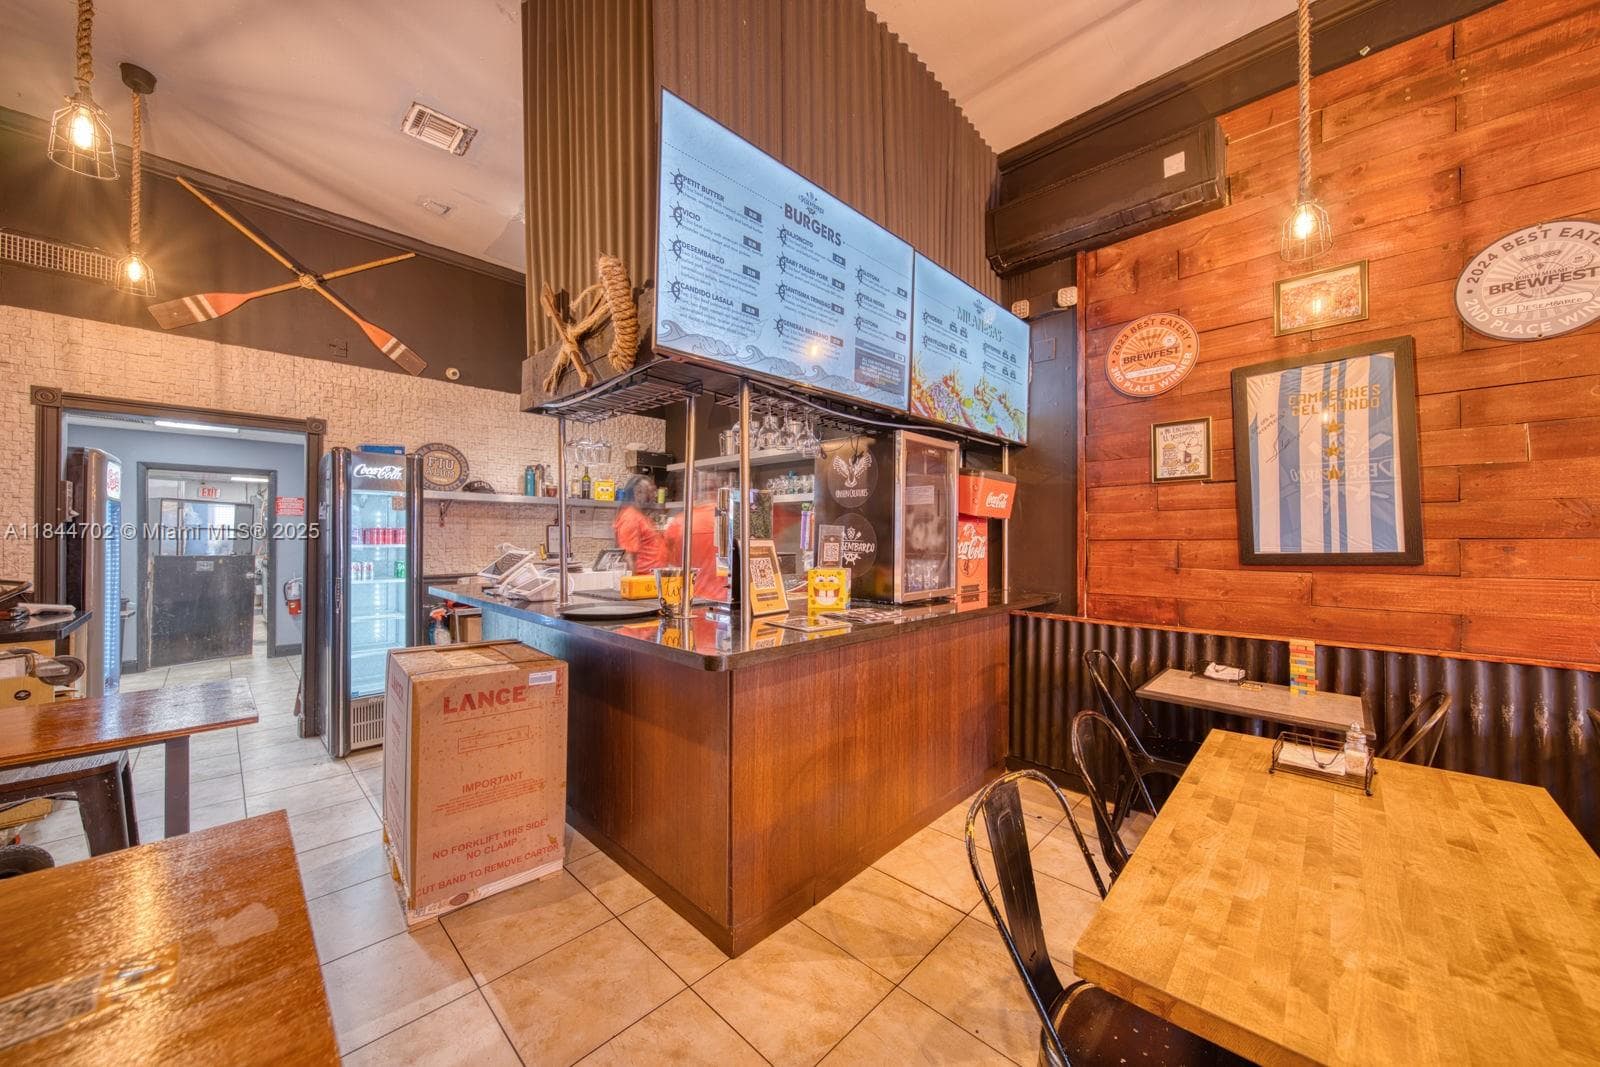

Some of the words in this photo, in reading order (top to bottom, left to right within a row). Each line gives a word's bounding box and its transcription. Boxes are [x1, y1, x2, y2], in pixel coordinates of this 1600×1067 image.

[683, 176, 701, 190] PETIT
[701, 185, 725, 202] BUTTER
[784, 202, 842, 247] BURGERS
[681, 241, 725, 265] DESEMBARCO
[1467, 252, 1498, 284] 2024
[1501, 228, 1552, 252] BEST
[1488, 266, 1600, 296] BREWFEST
[1464, 298, 1490, 322] 2ND
[1490, 319, 1553, 335] PLACE
[1113, 334, 1130, 356] 2023
[1130, 318, 1156, 335] BEST
[1159, 317, 1192, 342] EATERY
[1122, 346, 1180, 365] BREWFEST
[1123, 381, 1156, 393] PLACE
[1158, 351, 1193, 389] WINNER
[1288, 383, 1381, 406] CAMPEONES
[1292, 404, 1319, 417] DEL
[1327, 397, 1380, 413] MUNDO
[353, 463, 403, 480] Coca-Cola
[428, 456, 455, 470] FIU
[201, 487, 219, 498] EXIT
[443, 684, 528, 715] LANCE
[462, 771, 524, 794] IMPORTANT
[432, 849, 449, 860] NO
[451, 833, 500, 855] FORKLIFT
[502, 825, 523, 839] THIS
[466, 849, 481, 860] NO
[484, 838, 518, 855] CLAMP
[415, 882, 436, 898] CUT
[438, 873, 467, 889] BAND
[469, 868, 482, 879] TO
[484, 855, 522, 875] REMOVE
[524, 842, 559, 860] CARTON
